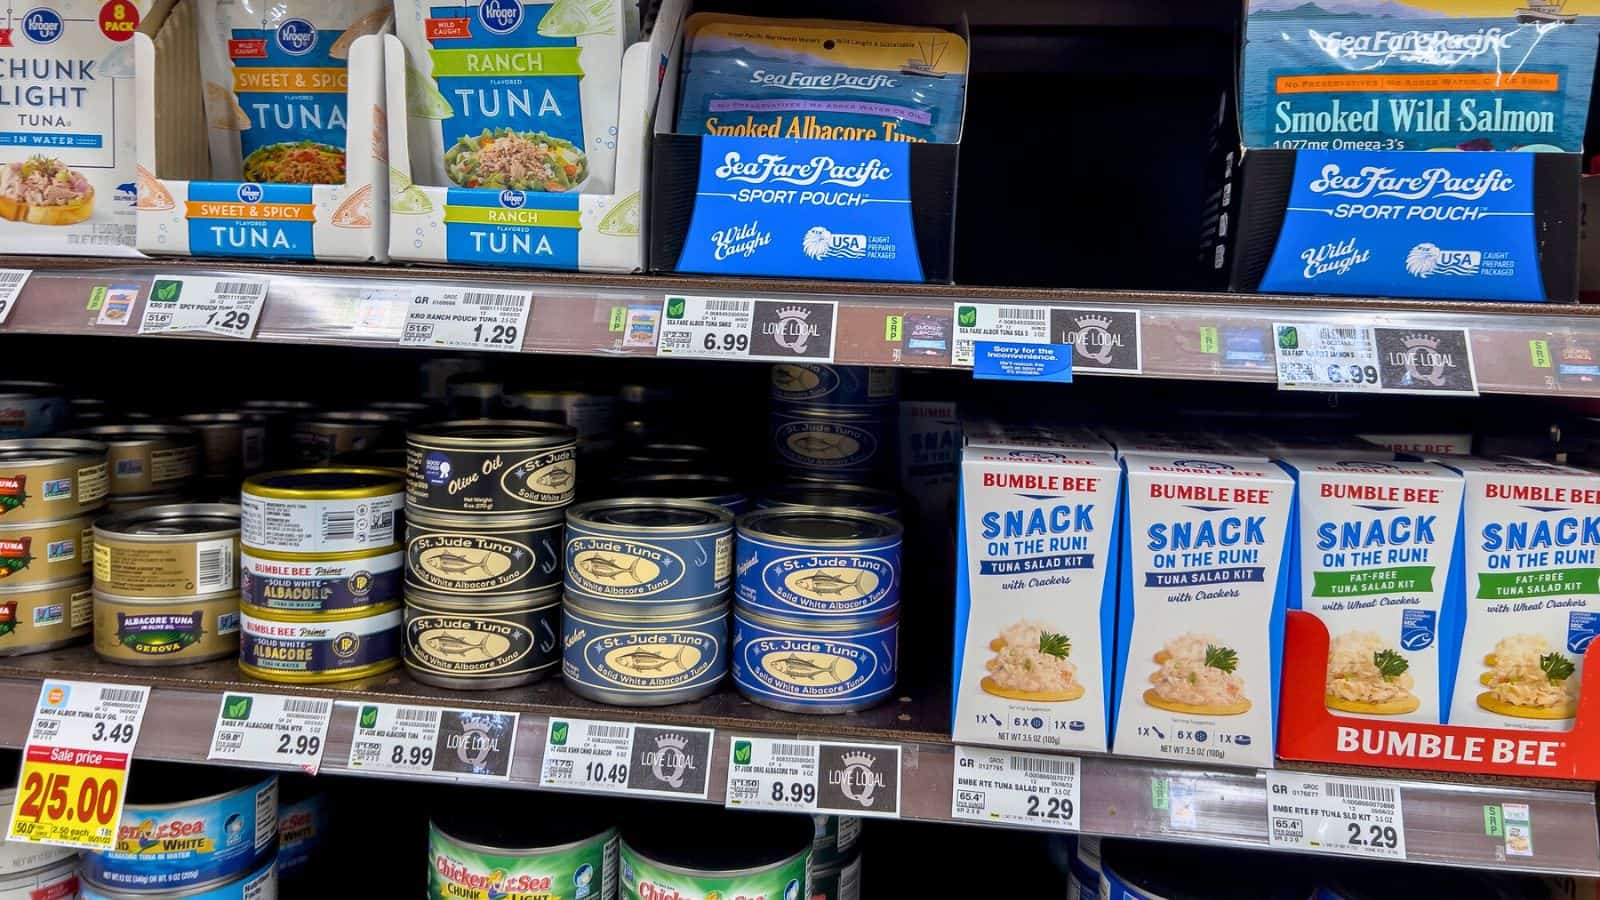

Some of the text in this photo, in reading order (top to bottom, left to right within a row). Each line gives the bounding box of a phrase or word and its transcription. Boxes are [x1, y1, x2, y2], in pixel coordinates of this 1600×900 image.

[114, 4, 124, 18] 8
[28, 19, 60, 40] Kroger
[104, 20, 134, 32] PACK
[433, 28, 462, 36] CAUGHT
[466, 53, 544, 72] RANCH
[0, 85, 87, 108] LIGHT
[454, 88, 563, 118] TUNA
[17, 113, 66, 127] TUNA
[252, 103, 347, 130] TUNA
[1275, 98, 1556, 134] Smoked Wild Salmon
[13, 136, 75, 145] IN WATER
[1309, 164, 1516, 202] Sea Fare Pacific
[737, 188, 863, 207] SPORT POUCH
[200, 204, 302, 219] SWEET & SPICY
[488, 209, 539, 224] RANCH
[1334, 203, 1479, 222] SPORT POUCH
[210, 226, 290, 250] TUNA
[711, 220, 758, 246] Wild
[832, 236, 860, 249] USA
[470, 231, 554, 256] TUNA
[714, 233, 772, 261] Caught
[1301, 236, 1356, 264] Wild
[867, 252, 897, 260] PACKAGED
[1303, 247, 1371, 280] Caught
[1440, 254, 1473, 266] USA
[1482, 251, 1509, 260] CAUGHT
[1482, 260, 1515, 268] PREPARED
[414, 296, 430, 305] GR
[205, 310, 251, 331] 1.29
[426, 313, 452, 321] RANCH
[452, 314, 478, 323] POUCH
[473, 323, 518, 345] 1.29
[762, 321, 821, 338] LOVE LOCAL
[703, 332, 749, 352] 6.99
[992, 345, 1055, 355] Sorry for the
[1327, 364, 1379, 385] 6.99
[448, 454, 503, 495] Olive Oil
[983, 473, 1098, 493] BUMBLE BEE
[1149, 483, 1271, 505] BUMBLE BEE
[1319, 483, 1440, 505] BUMBLE BEE
[1485, 483, 1567, 503] BUMBLE
[981, 503, 1096, 540] SNACK
[1147, 515, 1267, 551] SNACK
[1316, 514, 1438, 551] SNACK
[1481, 516, 1600, 552] SNACK
[987, 535, 1088, 557] ON THE RUN!
[782, 556, 882, 571] St. Jude Tuna
[991, 555, 1083, 574] TUNA SALAD KIT
[1153, 548, 1259, 569] ON THE RUN!
[1322, 548, 1428, 568] ON THE RUN!
[255, 564, 345, 577] BUMBLE BEE Prime
[1349, 570, 1398, 582] FAT-FREE
[1515, 572, 1565, 584] FAT-FREE
[268, 579, 322, 588] SOLID WHITE
[1001, 575, 1072, 591] with Crackers
[1331, 579, 1416, 593] TUNA SALAD KIT
[776, 585, 886, 610] Solid White Albacore Tuna
[1321, 595, 1421, 612] with Wheat Crackers
[124, 615, 194, 626] ALBACORE TUNA
[246, 622, 328, 637] BUMBLE BEE Prime
[135, 642, 181, 653] GENOVA
[603, 633, 704, 650] St. Jude Tuna
[760, 639, 860, 659] St. Jude Tuna
[253, 646, 313, 660] ALBACORE
[597, 661, 709, 687] Solid White Albacore Tuna
[91, 721, 134, 744] 3.49
[998, 732, 1010, 742] NET
[1010, 733, 1022, 742] WT
[277, 733, 320, 756] 2.99
[1336, 726, 1559, 767] BUMBLE BEE
[50, 748, 103, 765] Sale price
[391, 744, 433, 767] 8.99
[959, 757, 975, 769] GR
[585, 760, 628, 784] 10.49
[828, 770, 887, 789] LOVE LOCAL
[771, 780, 816, 804] 8.99
[994, 780, 1013, 791] TUNA
[1014, 782, 1037, 793] SALAD
[1038, 786, 1051, 794] KIT
[1271, 784, 1288, 795] GR
[19, 771, 119, 825] 2/5.00
[1026, 795, 1074, 820] 2.29
[1294, 805, 1310, 816] RTE
[1321, 809, 1341, 818] TUNA
[1342, 811, 1357, 821] SLD
[1358, 813, 1372, 822] KIT
[168, 819, 205, 838] Sea
[1347, 822, 1399, 850] 2.29
[162, 837, 206, 851] WHITE
[435, 855, 552, 893] Chicken Sea
